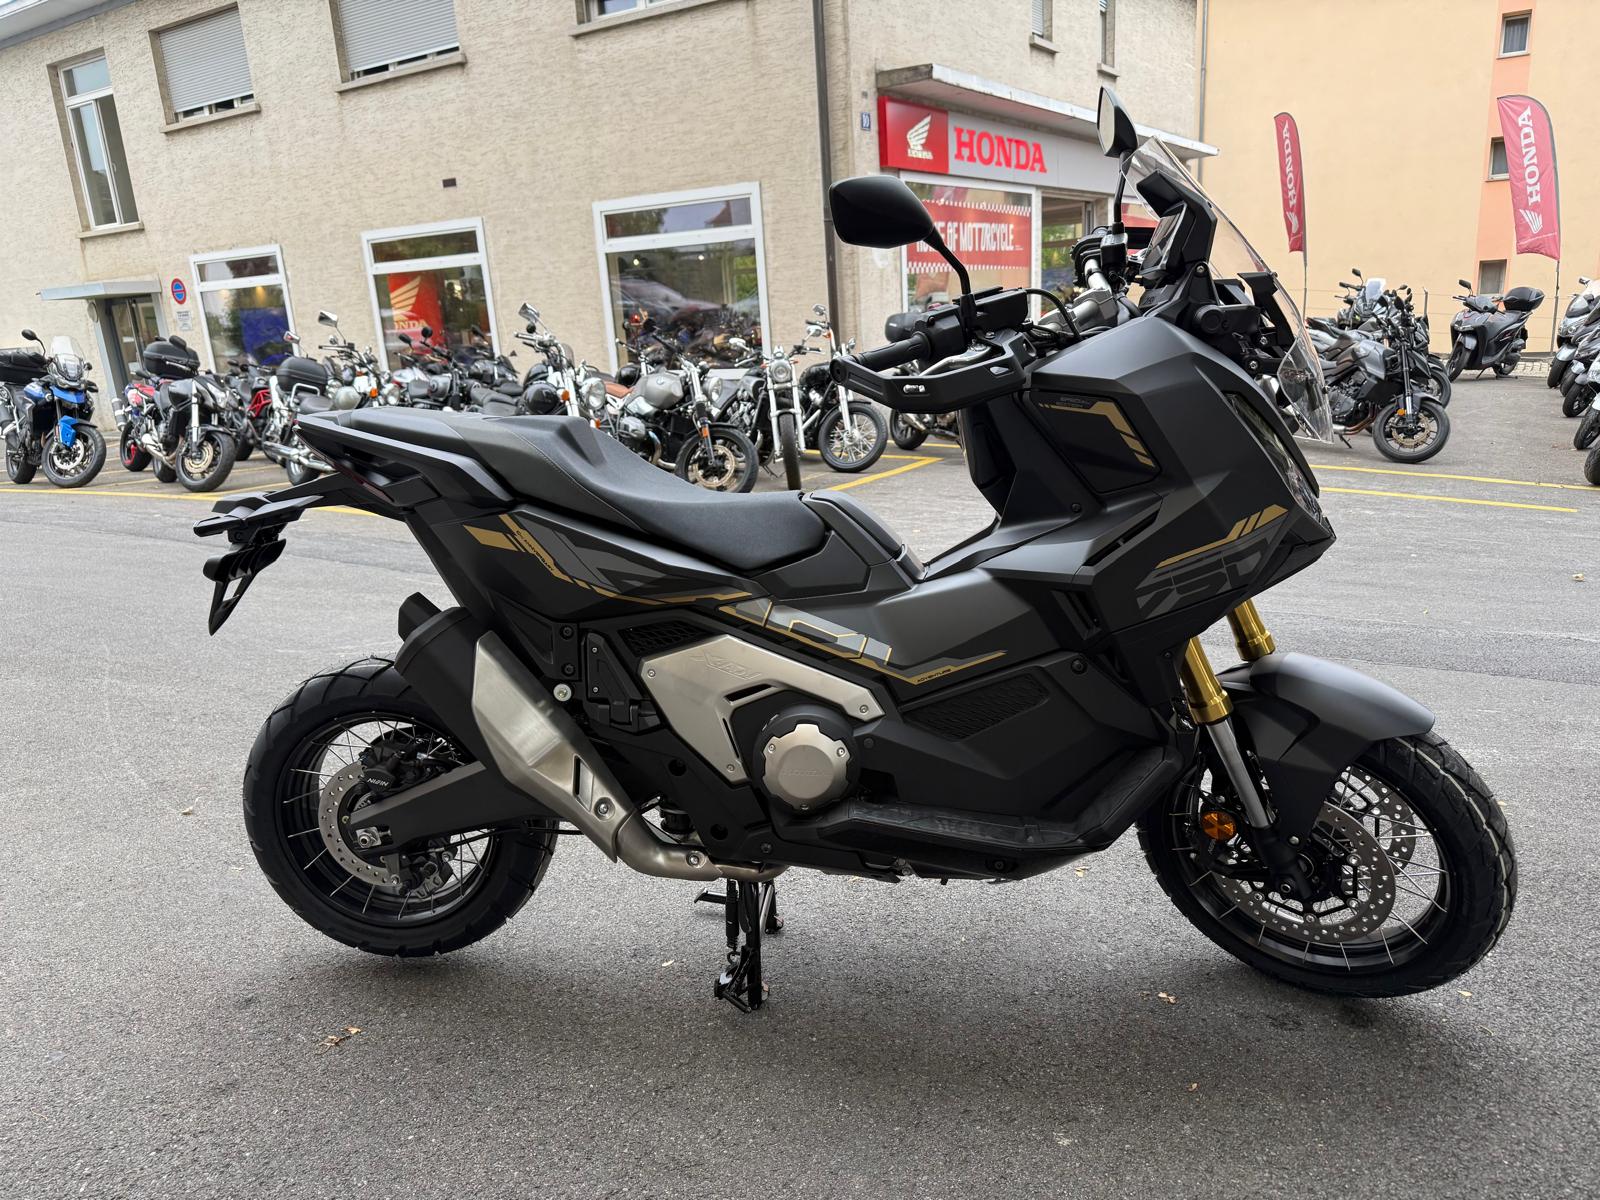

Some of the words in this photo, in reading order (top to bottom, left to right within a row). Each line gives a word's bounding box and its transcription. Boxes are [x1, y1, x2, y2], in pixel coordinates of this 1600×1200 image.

[954, 127, 1047, 173] HONDA
[1282, 119, 1296, 208] HONDA
[1518, 105, 1541, 206] HONDA
[946, 221, 958, 251] OF
